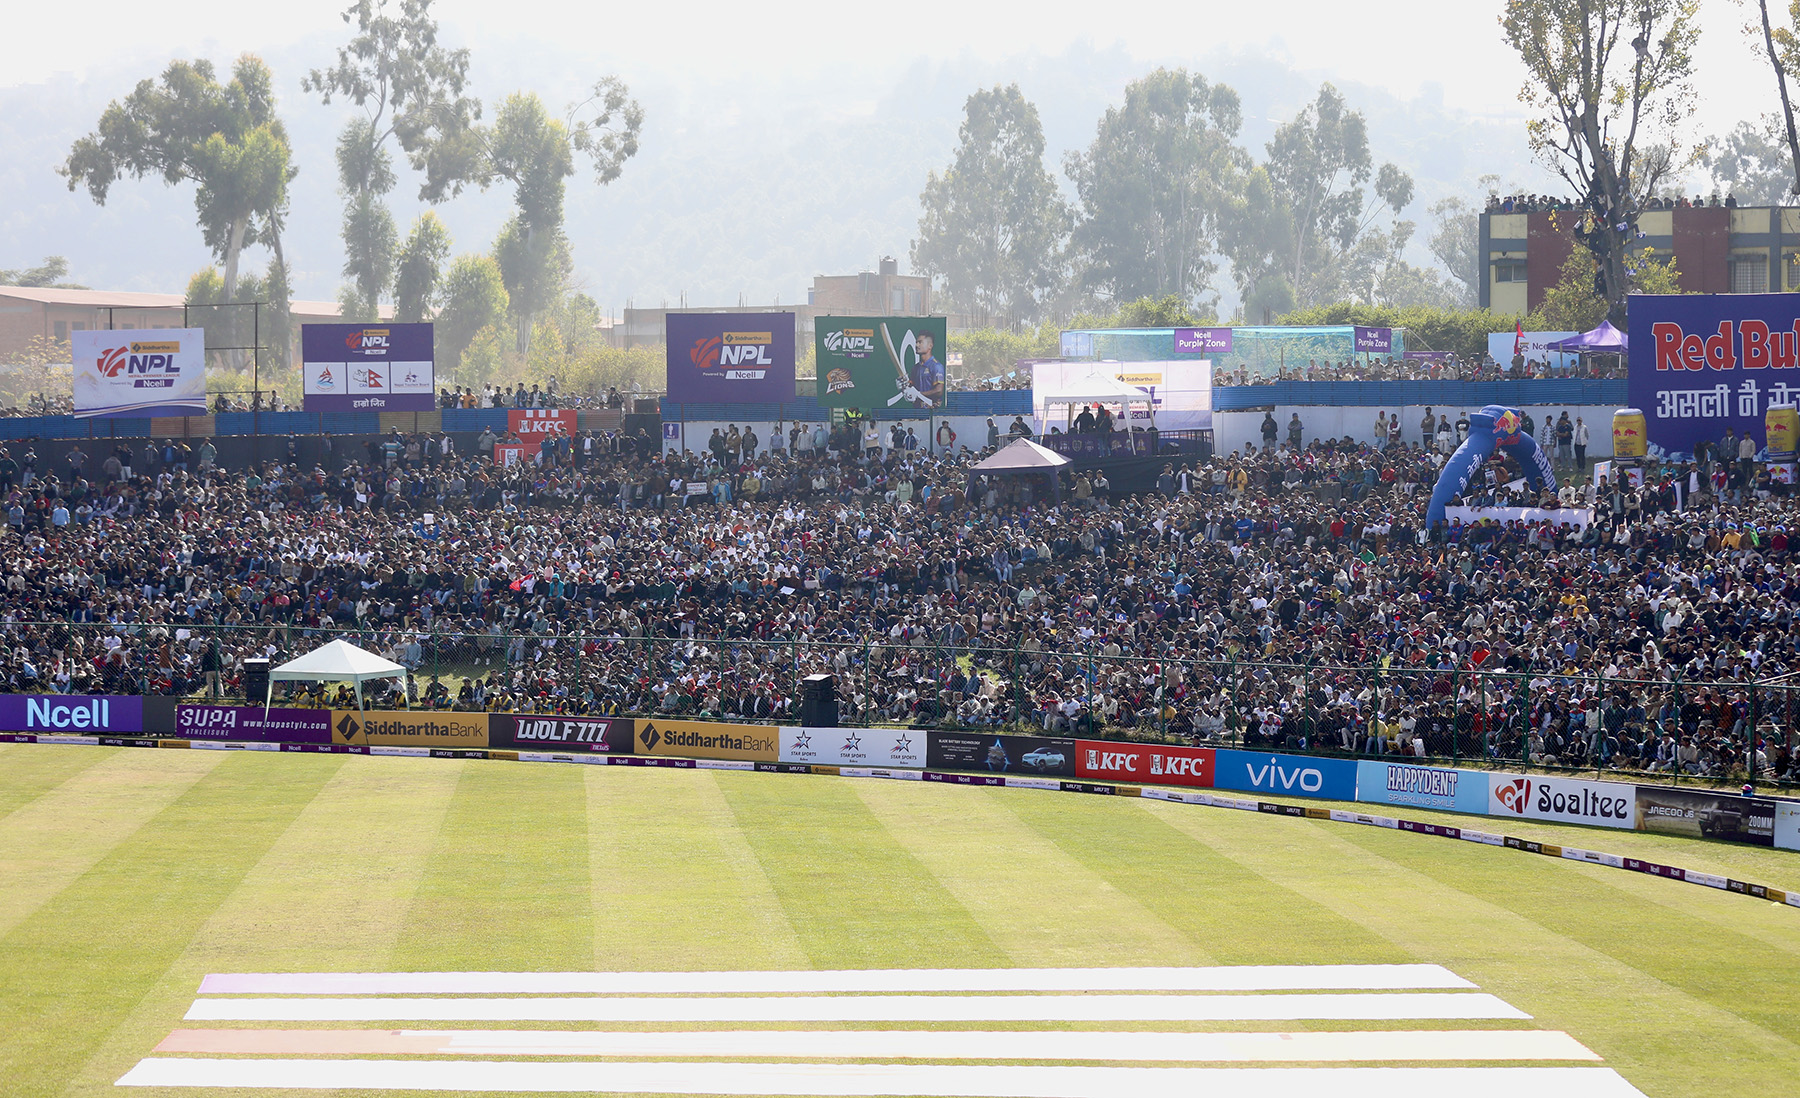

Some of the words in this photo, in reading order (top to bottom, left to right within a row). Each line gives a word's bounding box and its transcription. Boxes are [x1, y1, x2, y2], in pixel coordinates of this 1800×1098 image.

[362, 337, 390, 347] NPL
[842, 338, 874, 349] NPL
[1179, 340, 1204, 349] Purple
[1652, 320, 1737, 371] Red
[128, 354, 180, 373] NPL
[720, 346, 772, 365] NPL
[826, 381, 855, 394] LIONS
[1656, 384, 1730, 418] असली
[1738, 379, 1760, 416] नै
[532, 420, 564, 432] KFC
[27, 698, 109, 728] Ncell
[180, 708, 237, 728] SUPA
[243, 720, 327, 730] www.supastyle.com
[364, 720, 483, 737] SiddharthaBank
[516, 720, 608, 742] WOLF777
[664, 730, 774, 751] SiddharthaBank
[1100, 752, 1137, 772] KFC
[1164, 757, 1203, 776] KFC
[1246, 757, 1322, 792] vivo
[1387, 765, 1458, 796] HAPPYDENT
[1388, 794, 1431, 805] SPARKLING
[1432, 799, 1455, 808] SMILE
[1538, 784, 1627, 819] Soaltee
[1648, 806, 1683, 817] JAECOO
[1749, 815, 1773, 828] 200MM
